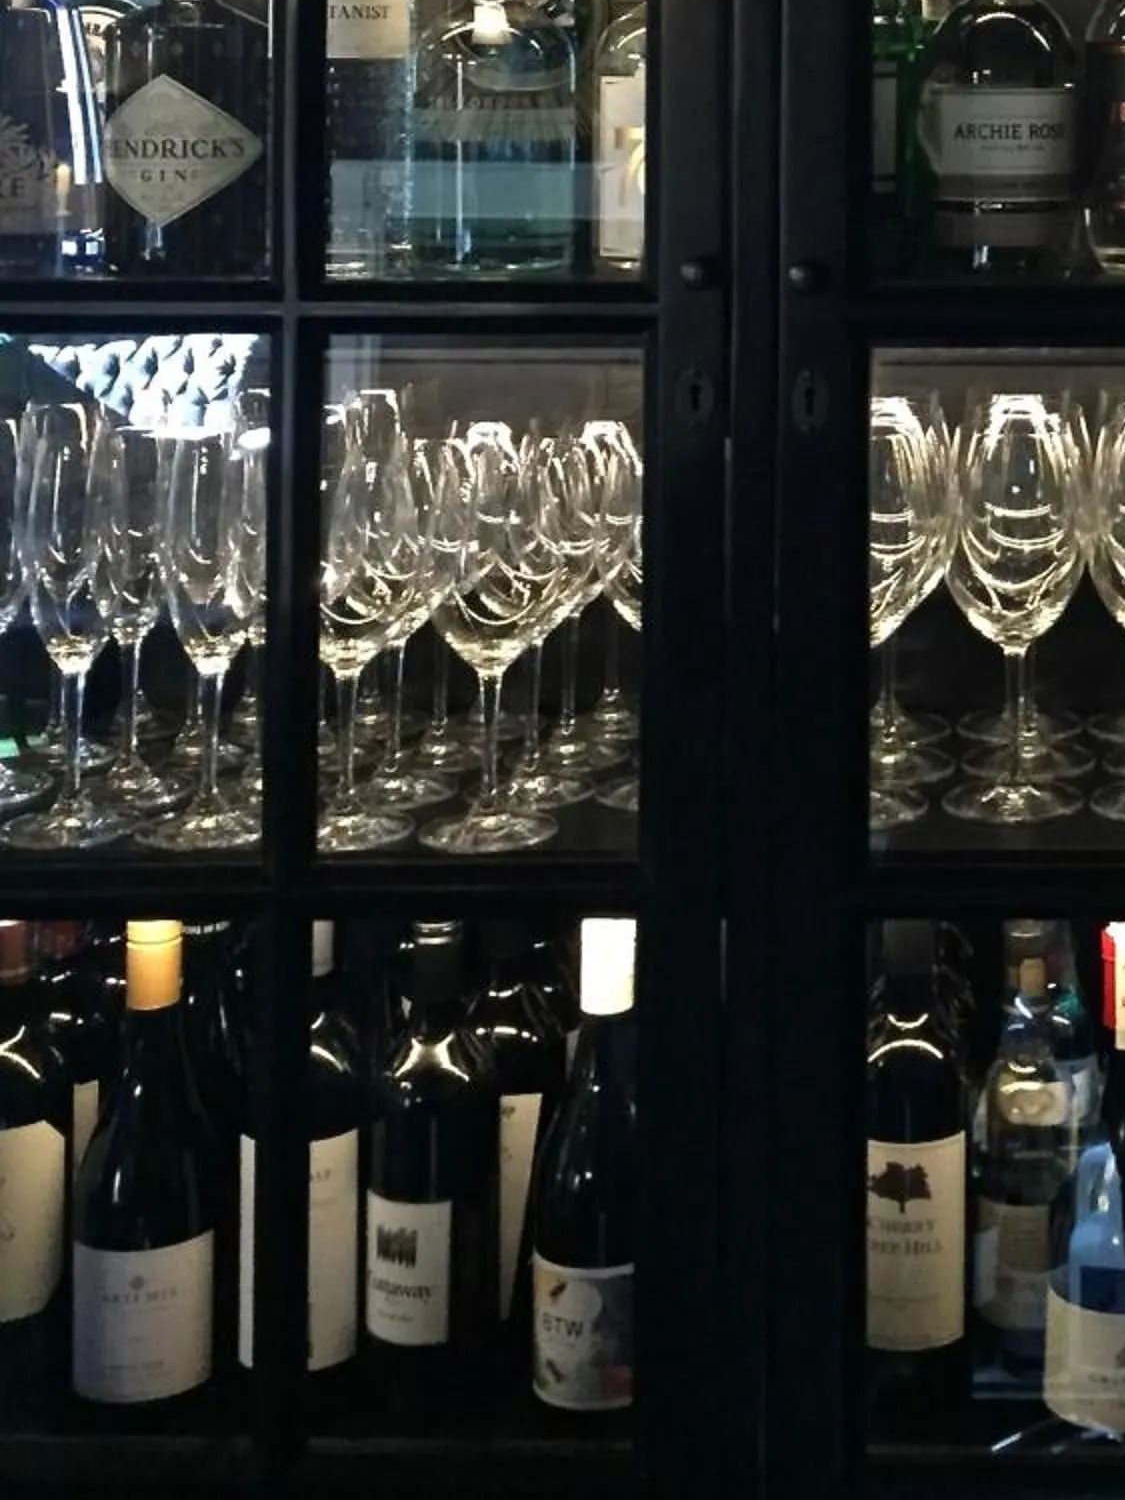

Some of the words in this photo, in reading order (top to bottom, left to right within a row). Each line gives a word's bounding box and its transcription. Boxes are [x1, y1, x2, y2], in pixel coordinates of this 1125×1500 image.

[953, 123, 1023, 141] ARCHIE
[110, 137, 246, 160] ENDRICK'S
[139, 168, 188, 183] GIN
